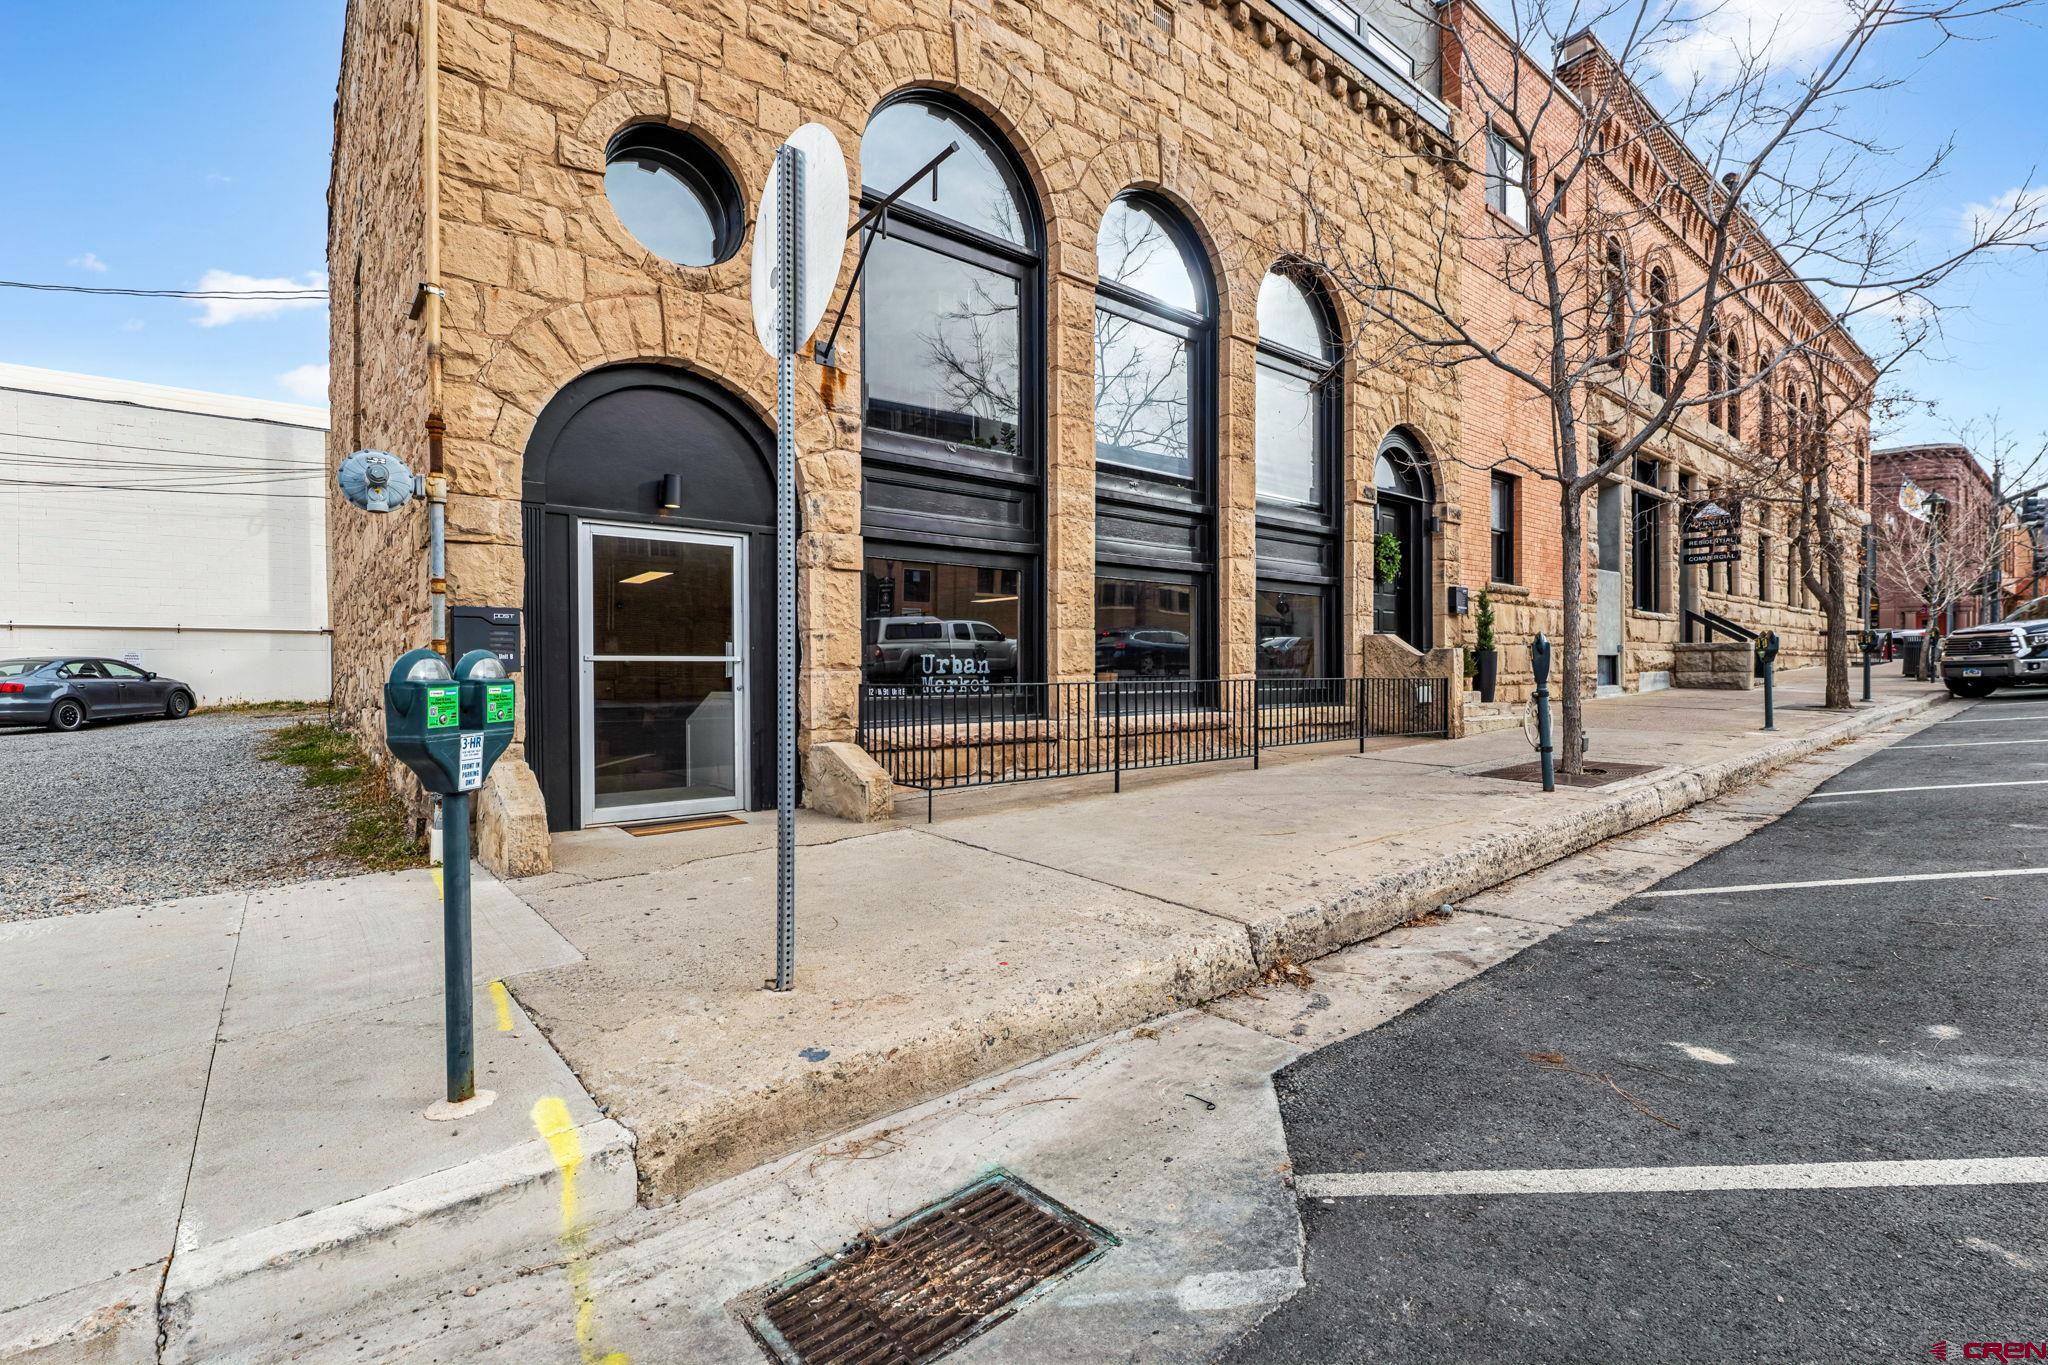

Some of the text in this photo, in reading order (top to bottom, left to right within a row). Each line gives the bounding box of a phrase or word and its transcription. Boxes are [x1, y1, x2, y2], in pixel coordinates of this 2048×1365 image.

[1689, 537, 1735, 547] RESIDENTIAL
[1689, 553, 1736, 562] COMMERCIAL
[920, 654, 991, 674] Urban
[920, 676, 990, 693] Market
[461, 769, 480, 779] PARKING
[465, 778, 476, 786] ONLY
